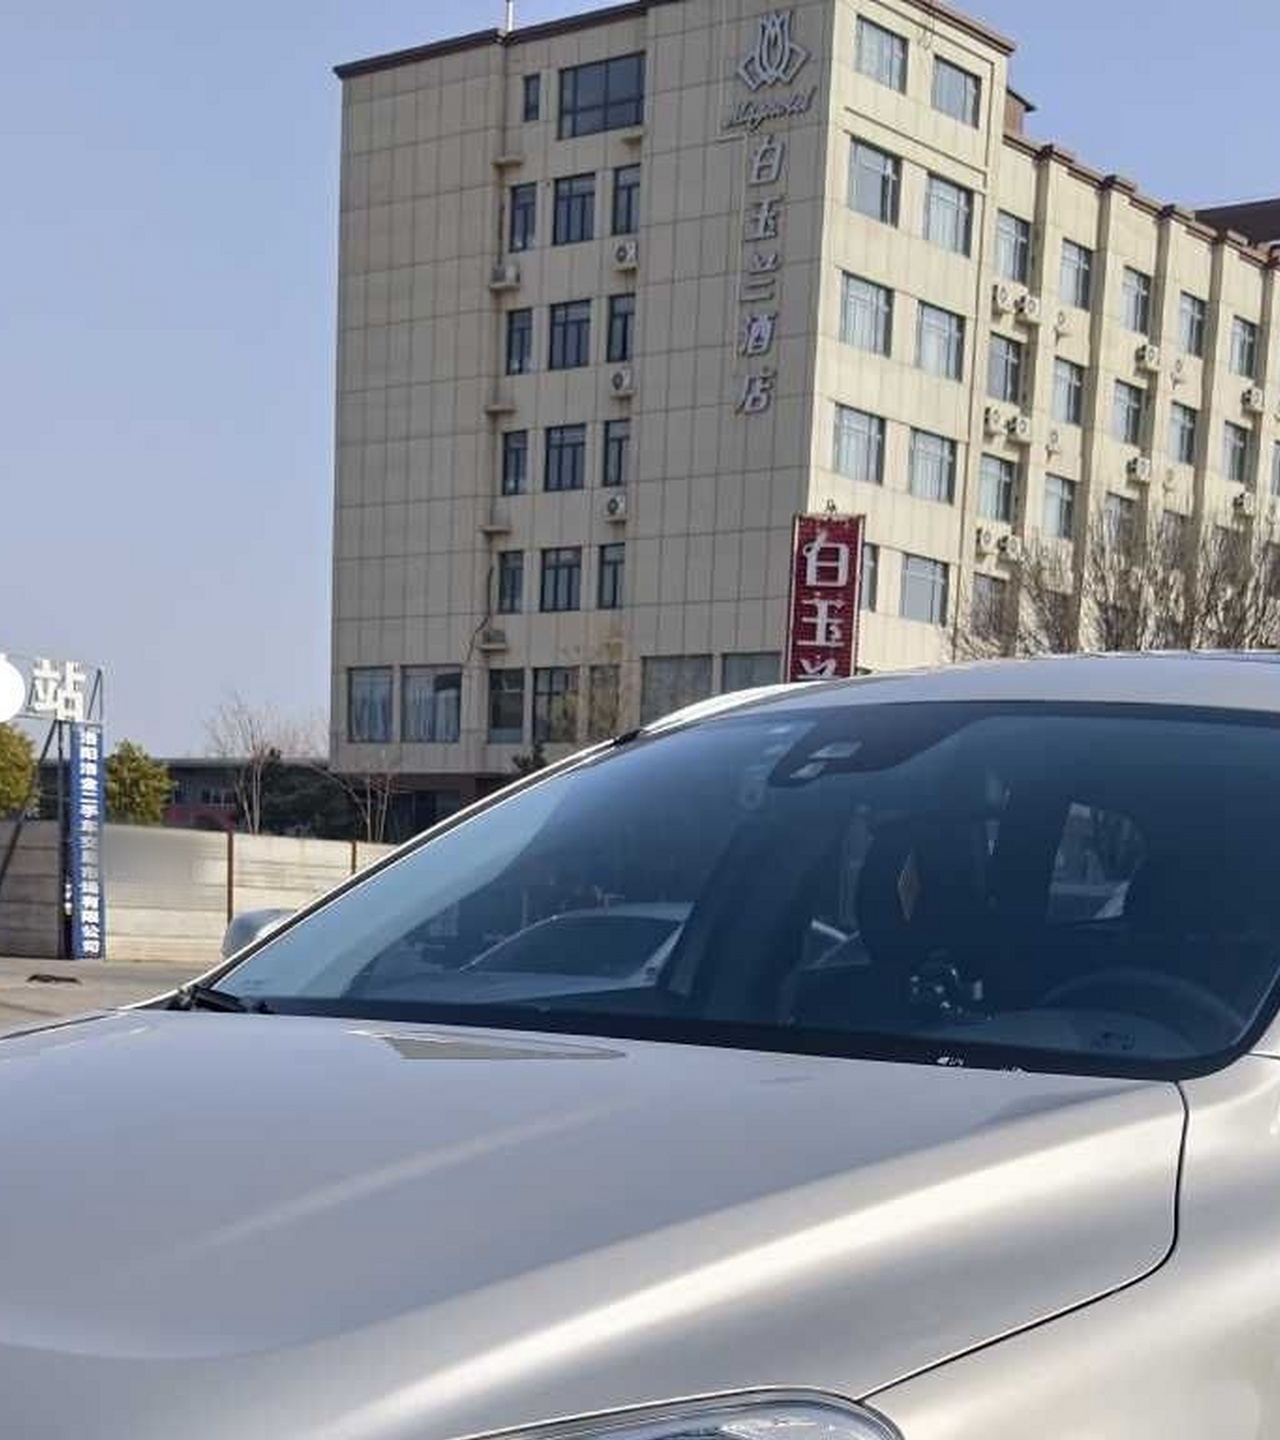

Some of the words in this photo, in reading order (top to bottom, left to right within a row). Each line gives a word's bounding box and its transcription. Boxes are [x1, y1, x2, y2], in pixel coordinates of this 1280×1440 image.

[737, 135, 785, 415] 白玉兰酒店
